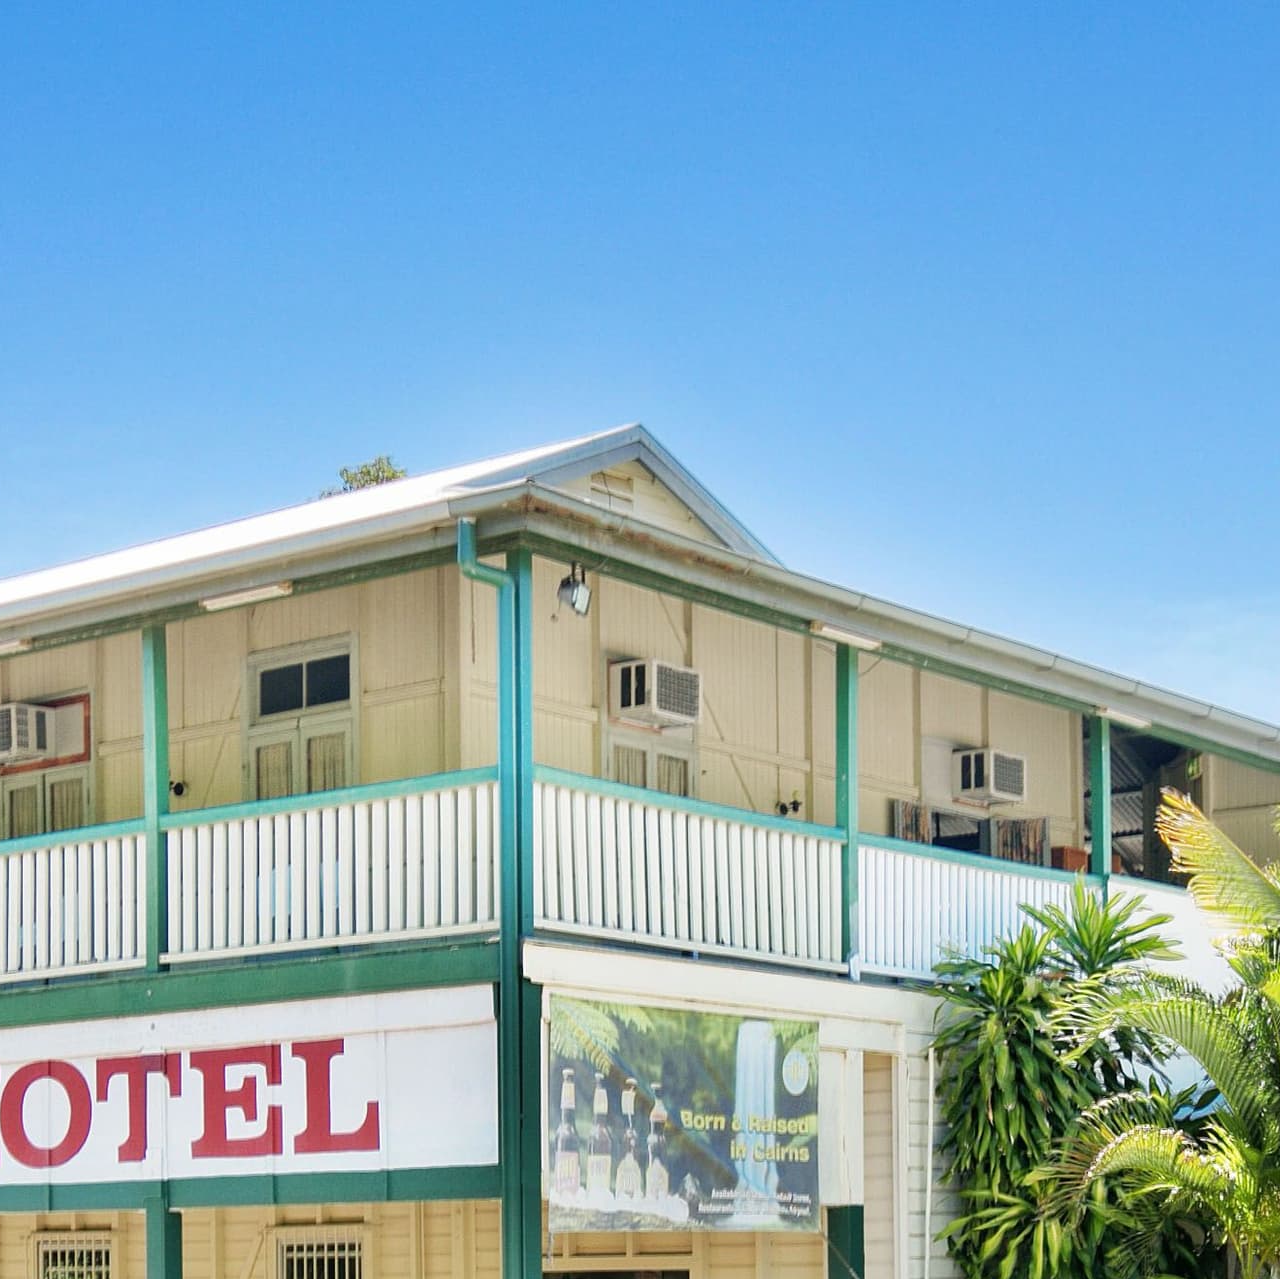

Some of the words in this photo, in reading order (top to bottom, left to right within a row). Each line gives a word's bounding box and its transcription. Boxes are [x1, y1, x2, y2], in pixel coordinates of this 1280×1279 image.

[679, 1109, 726, 1131] Born
[748, 1114, 809, 1135] Raised
[730, 1138, 747, 1160] in
[753, 1142, 810, 1162] Cairns
